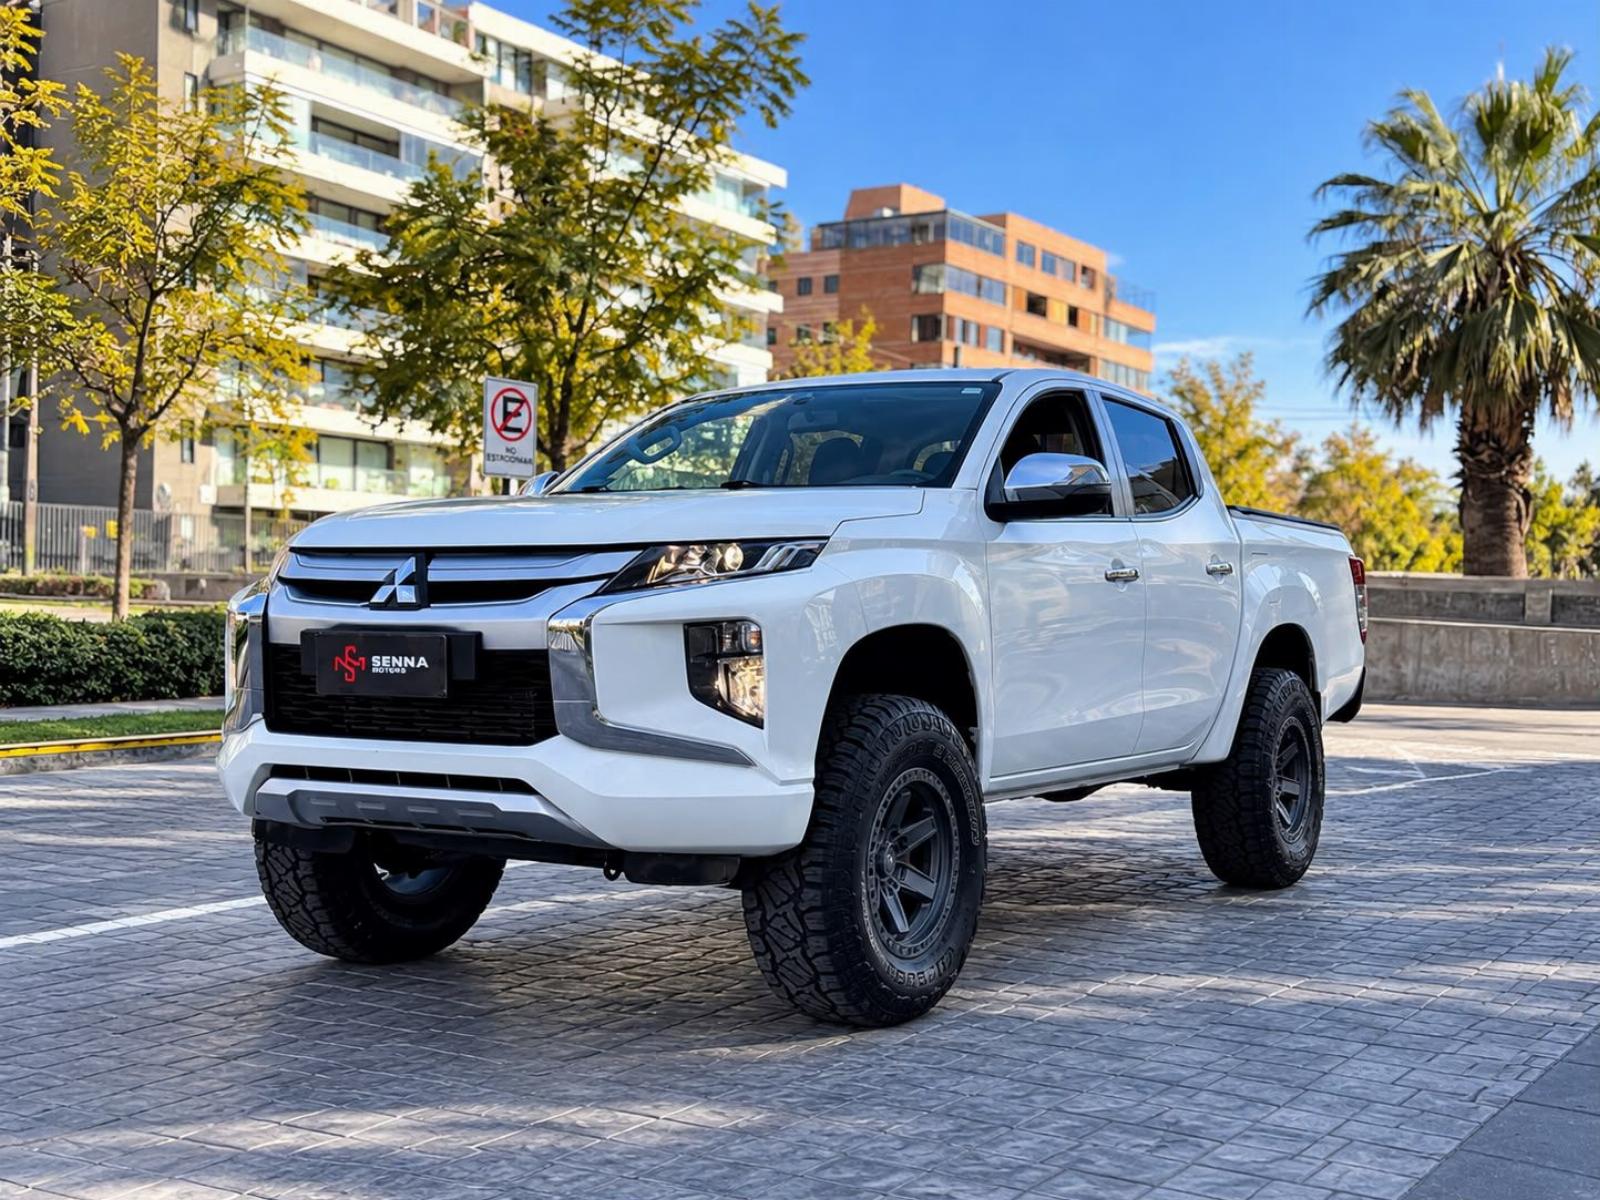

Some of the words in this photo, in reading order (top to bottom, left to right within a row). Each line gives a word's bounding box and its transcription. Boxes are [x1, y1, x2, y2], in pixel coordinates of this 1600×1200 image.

[503, 396, 524, 433] E
[505, 447, 517, 455] NO
[487, 453, 532, 464] ESTACONAR
[371, 655, 429, 668] SENNA
